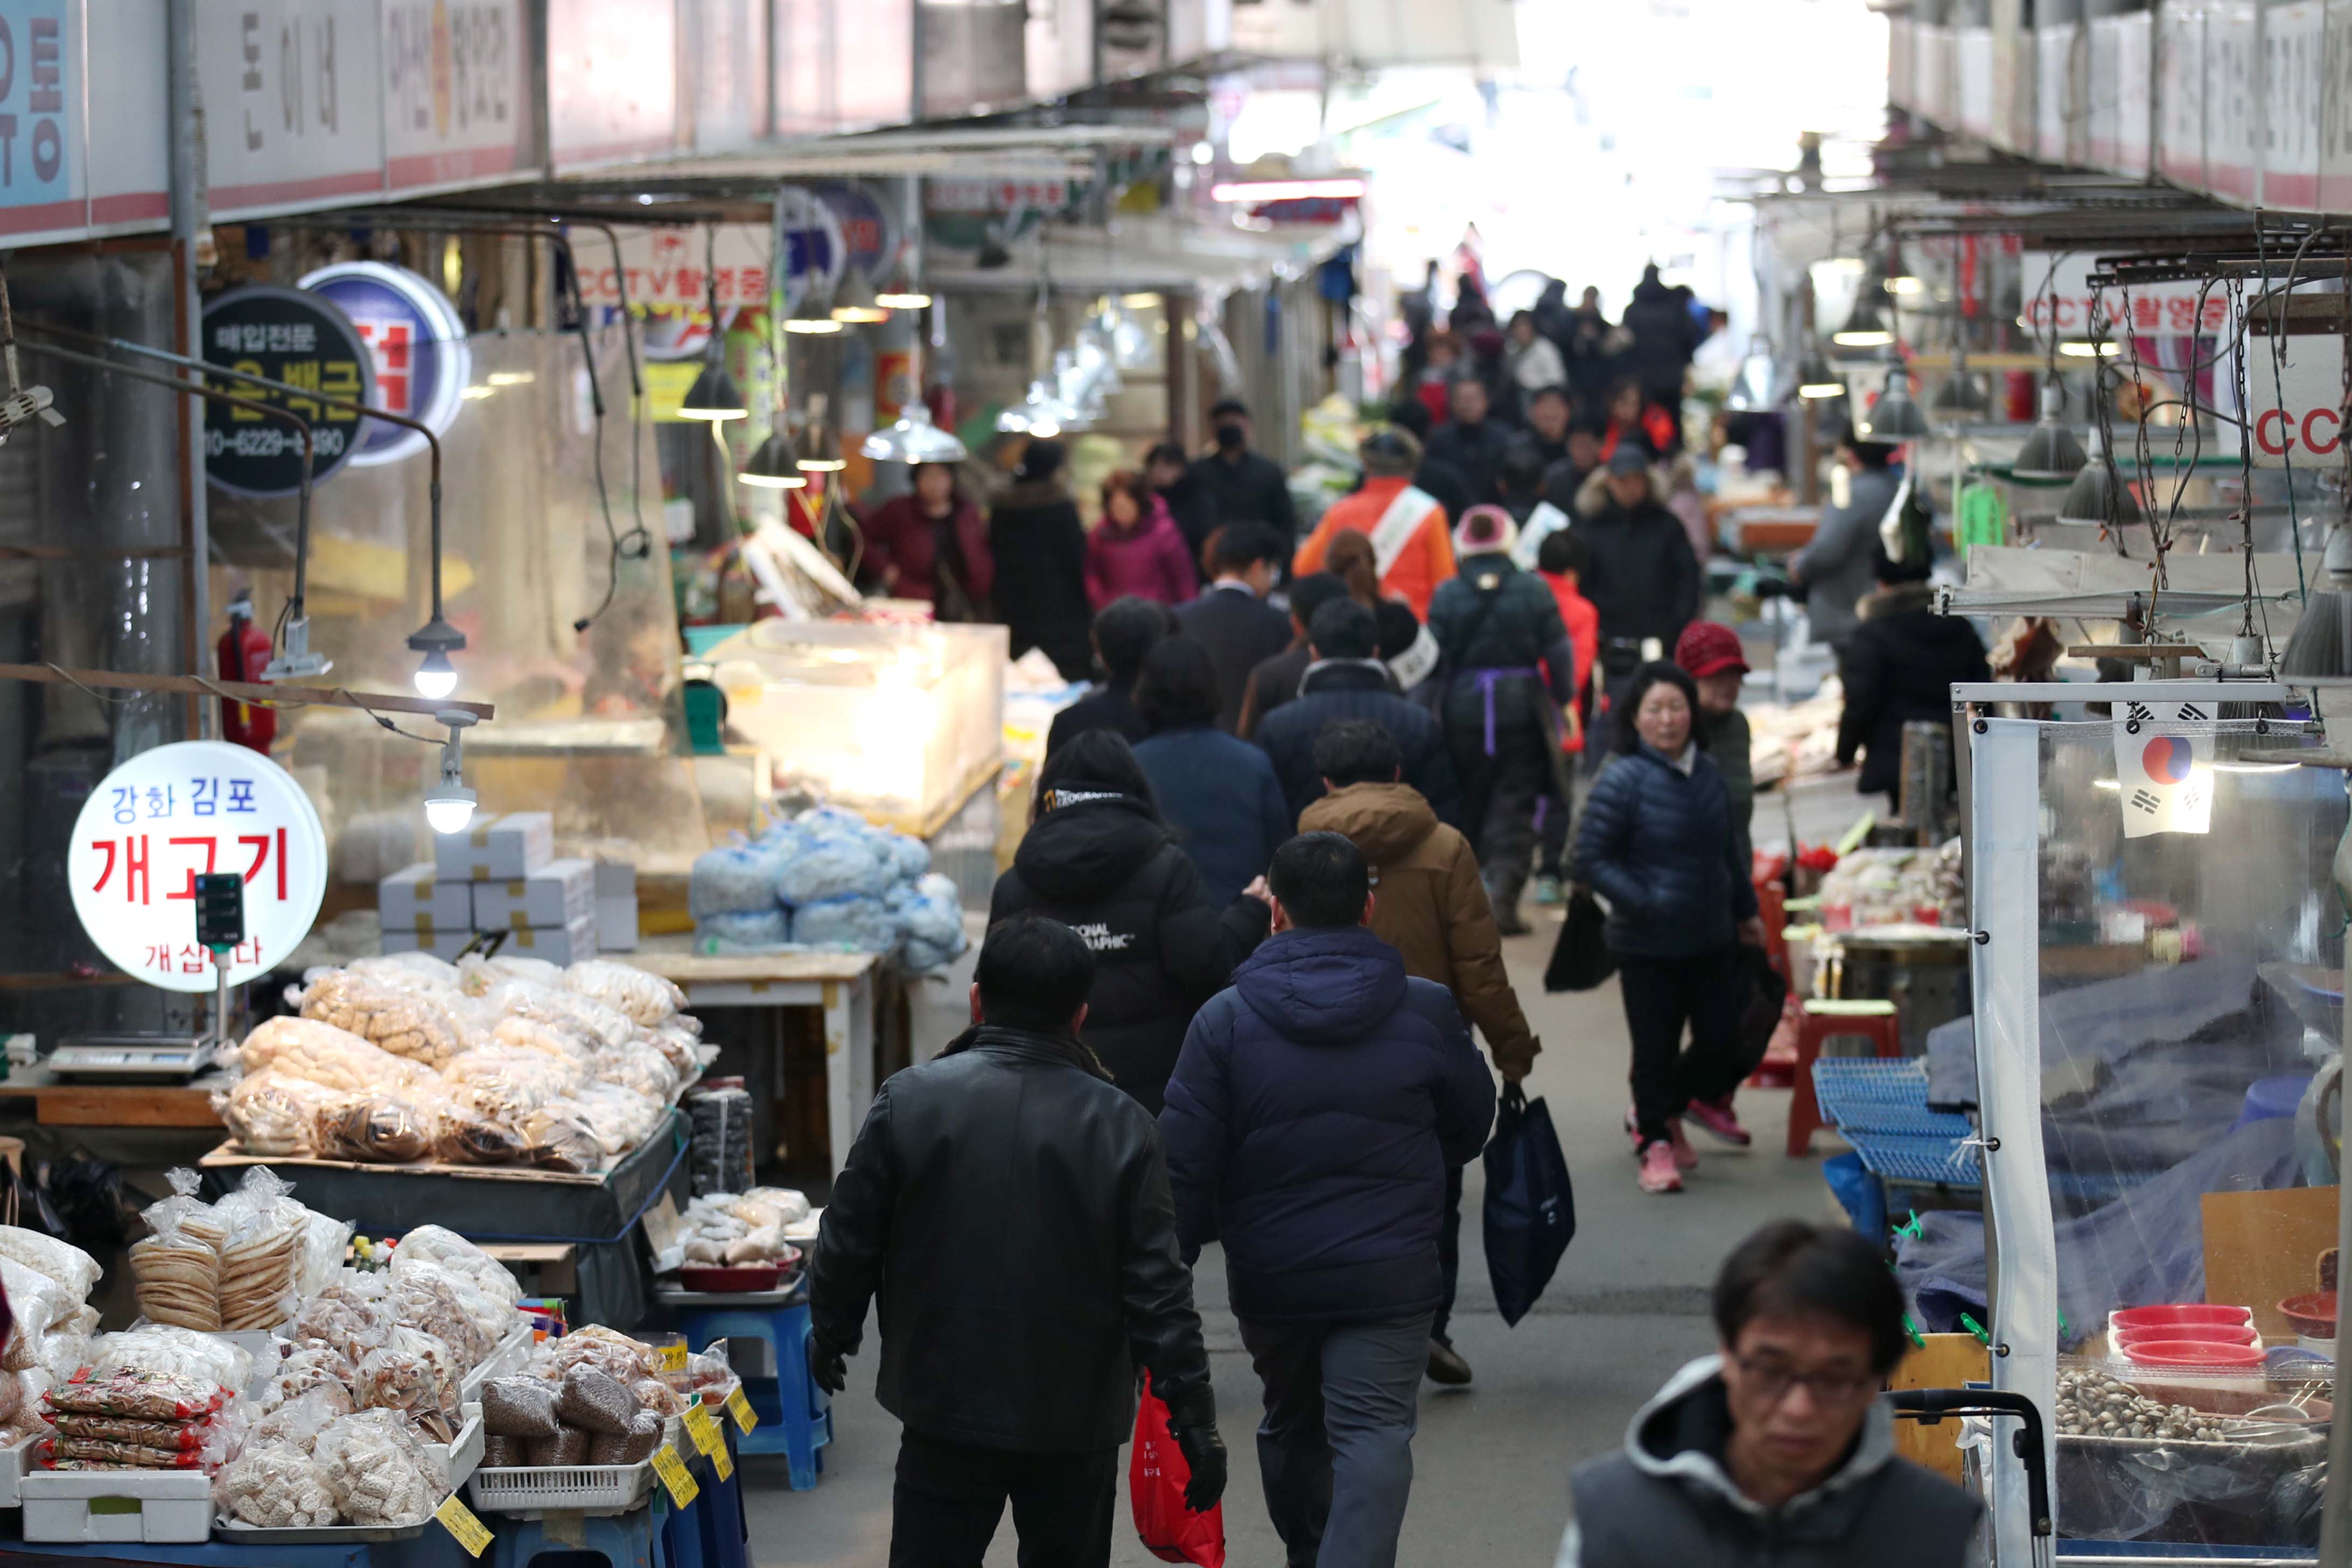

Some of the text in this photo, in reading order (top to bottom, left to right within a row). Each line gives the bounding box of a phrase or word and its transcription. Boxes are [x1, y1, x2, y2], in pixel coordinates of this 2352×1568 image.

[215, 324, 317, 352] 매입전문
[111, 777, 257, 824] 강화 김포
[92, 827, 288, 906] 개고기
[145, 935, 263, 973] 개 삽다
